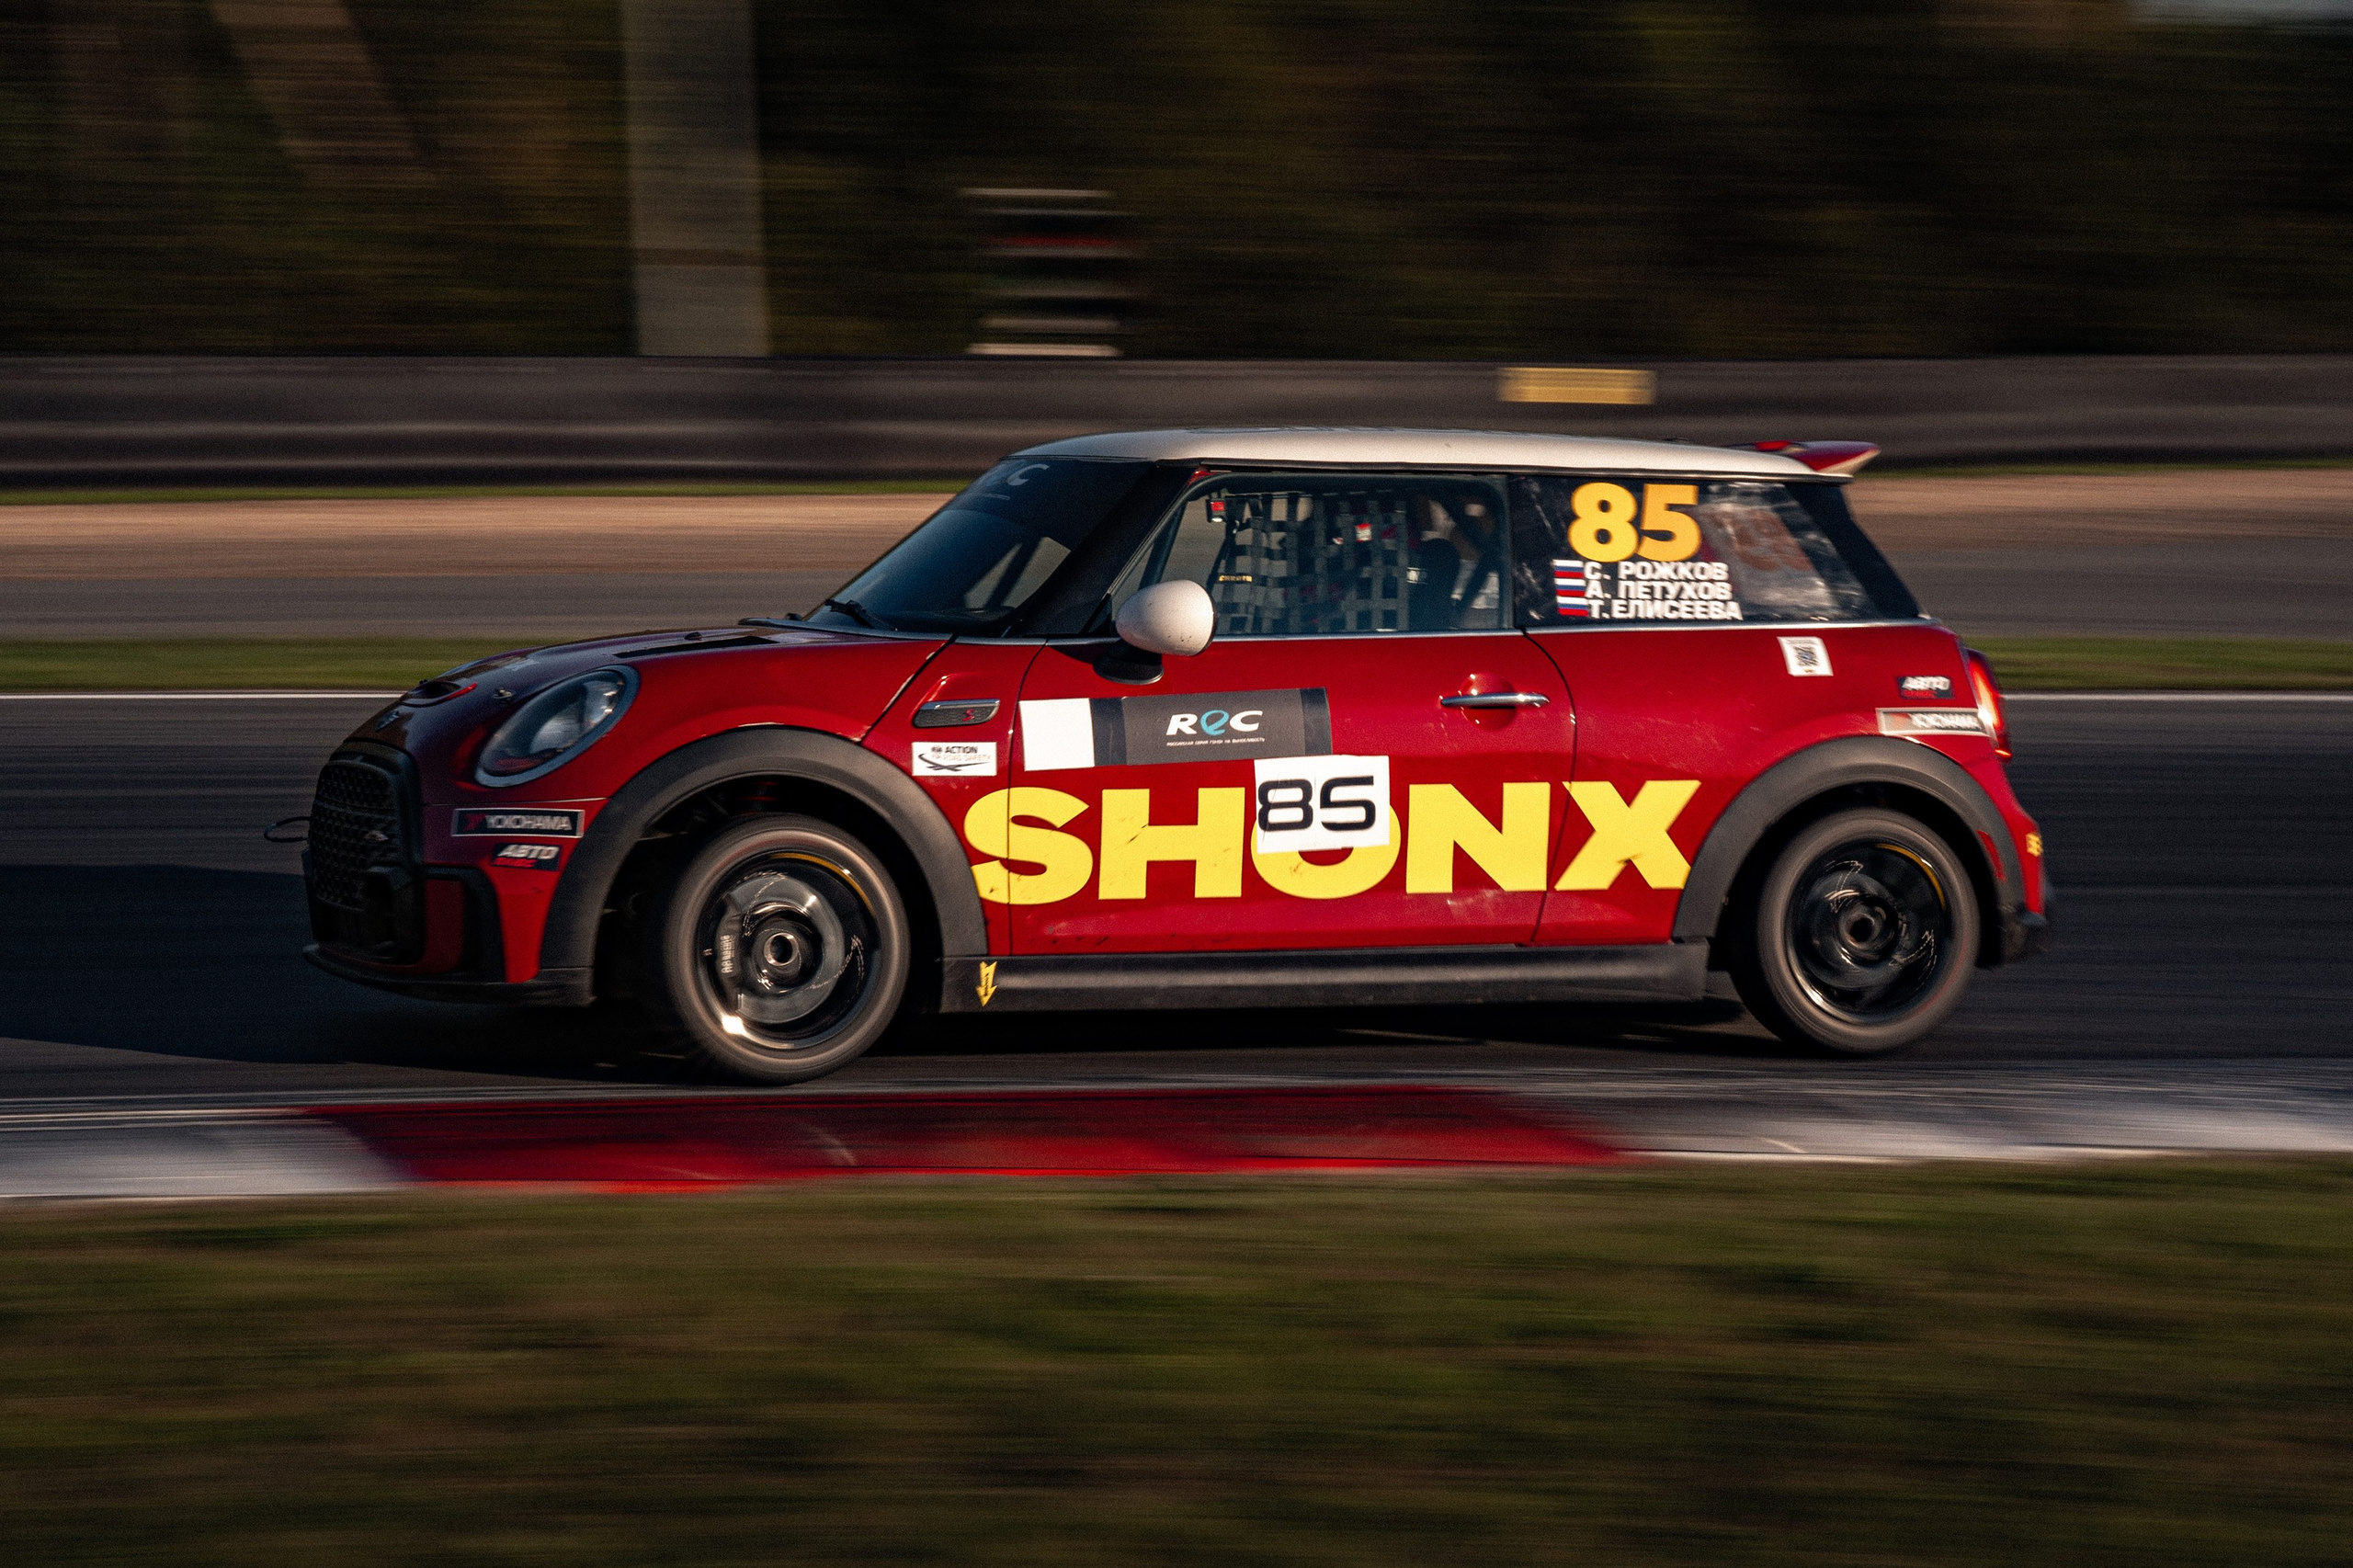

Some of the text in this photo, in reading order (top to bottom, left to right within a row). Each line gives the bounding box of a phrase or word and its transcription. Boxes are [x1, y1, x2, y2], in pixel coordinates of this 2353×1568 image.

[1568, 482, 1701, 562] 85
[1584, 562, 1729, 581] С. РОЖКОВ
[1585, 580, 1733, 600] А. ПЕТУХОВ
[945, 745, 978, 754] ACTION
[1257, 775, 1376, 833] 85
